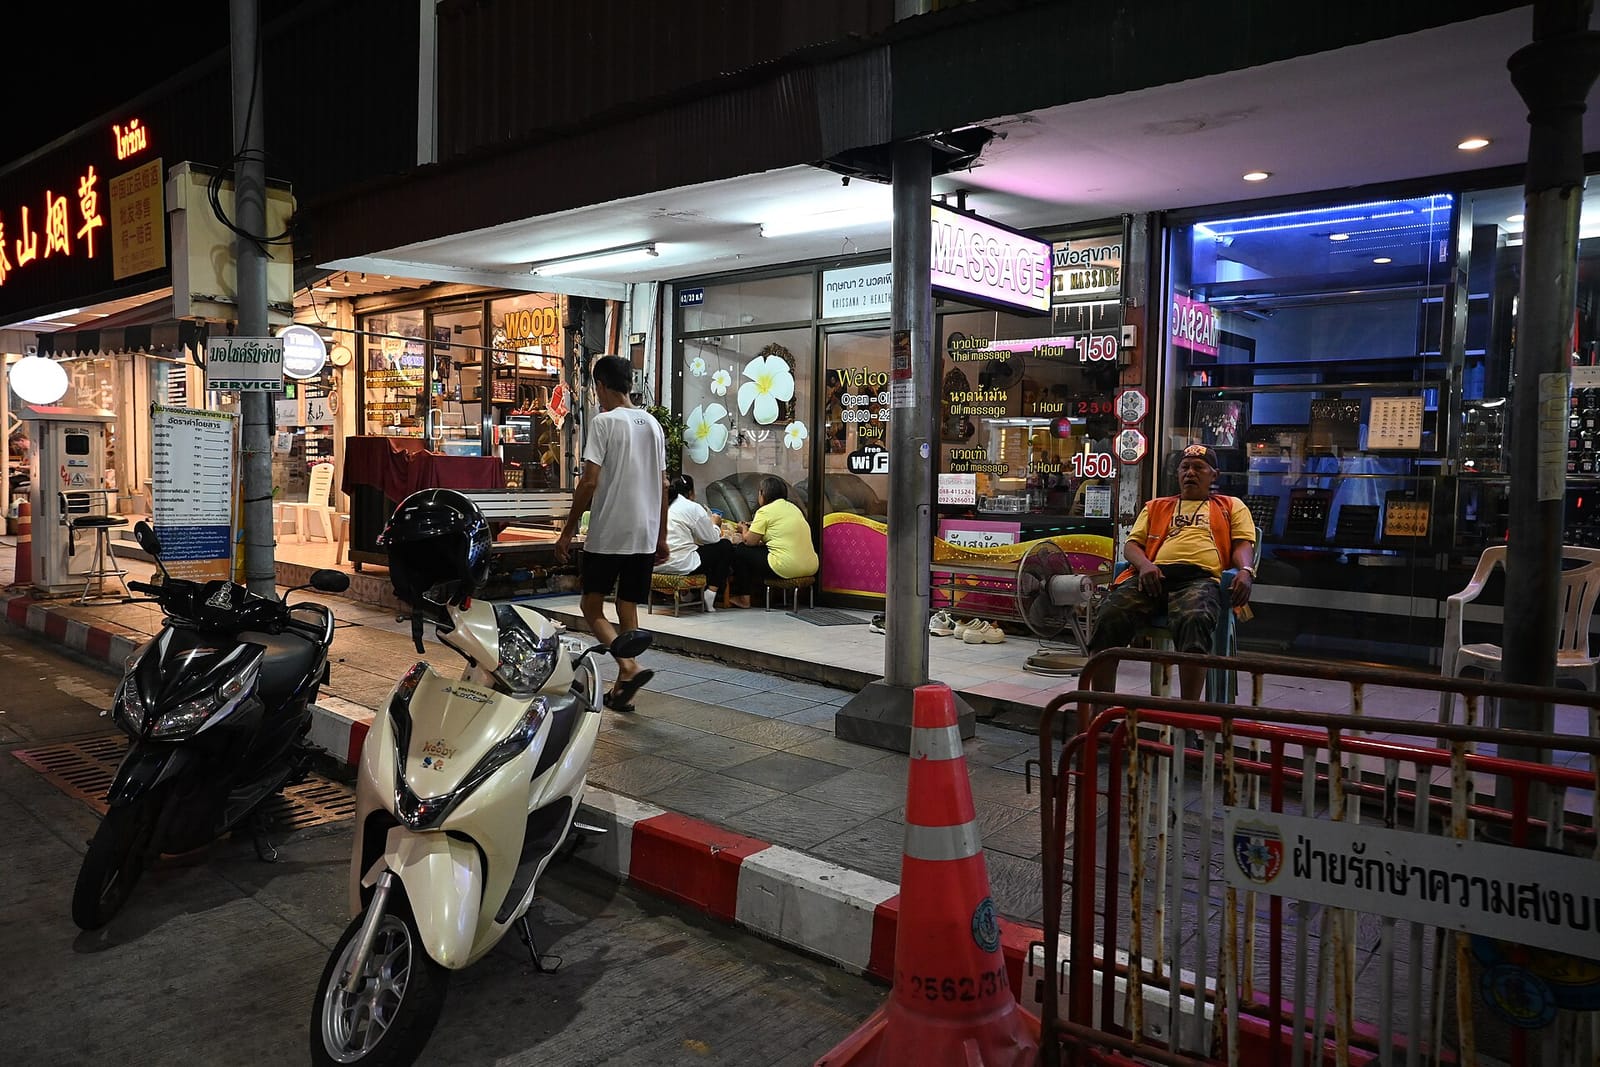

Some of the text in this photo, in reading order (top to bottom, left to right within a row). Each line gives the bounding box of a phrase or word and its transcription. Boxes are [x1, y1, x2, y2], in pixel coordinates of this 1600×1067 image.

[931, 219, 1046, 299] MASSAGE
[858, 278, 864, 288] 2
[863, 295, 867, 306] 2
[951, 335, 989, 350] นวดไทย
[951, 351, 970, 362] Thai
[971, 349, 1011, 363] massage
[1040, 345, 1065, 358] Hour
[1075, 335, 1118, 362] 150
[836, 366, 888, 387] Welco
[209, 381, 281, 390] SERVICE
[841, 393, 869, 407] Open
[949, 384, 1008, 402] นวดน้ำมัน
[841, 409, 870, 423] 09.00
[950, 404, 963, 416] Oil
[963, 404, 1006, 419] massage
[1040, 401, 1064, 413] Hour
[1077, 401, 1113, 414] 250
[859, 426, 884, 439] Daily
[950, 445, 988, 460] นวดเท้า
[950, 462, 969, 473] Foot
[970, 462, 1009, 475] massage
[1037, 461, 1062, 473] Hour
[458, 686, 488, 698] HONDA
